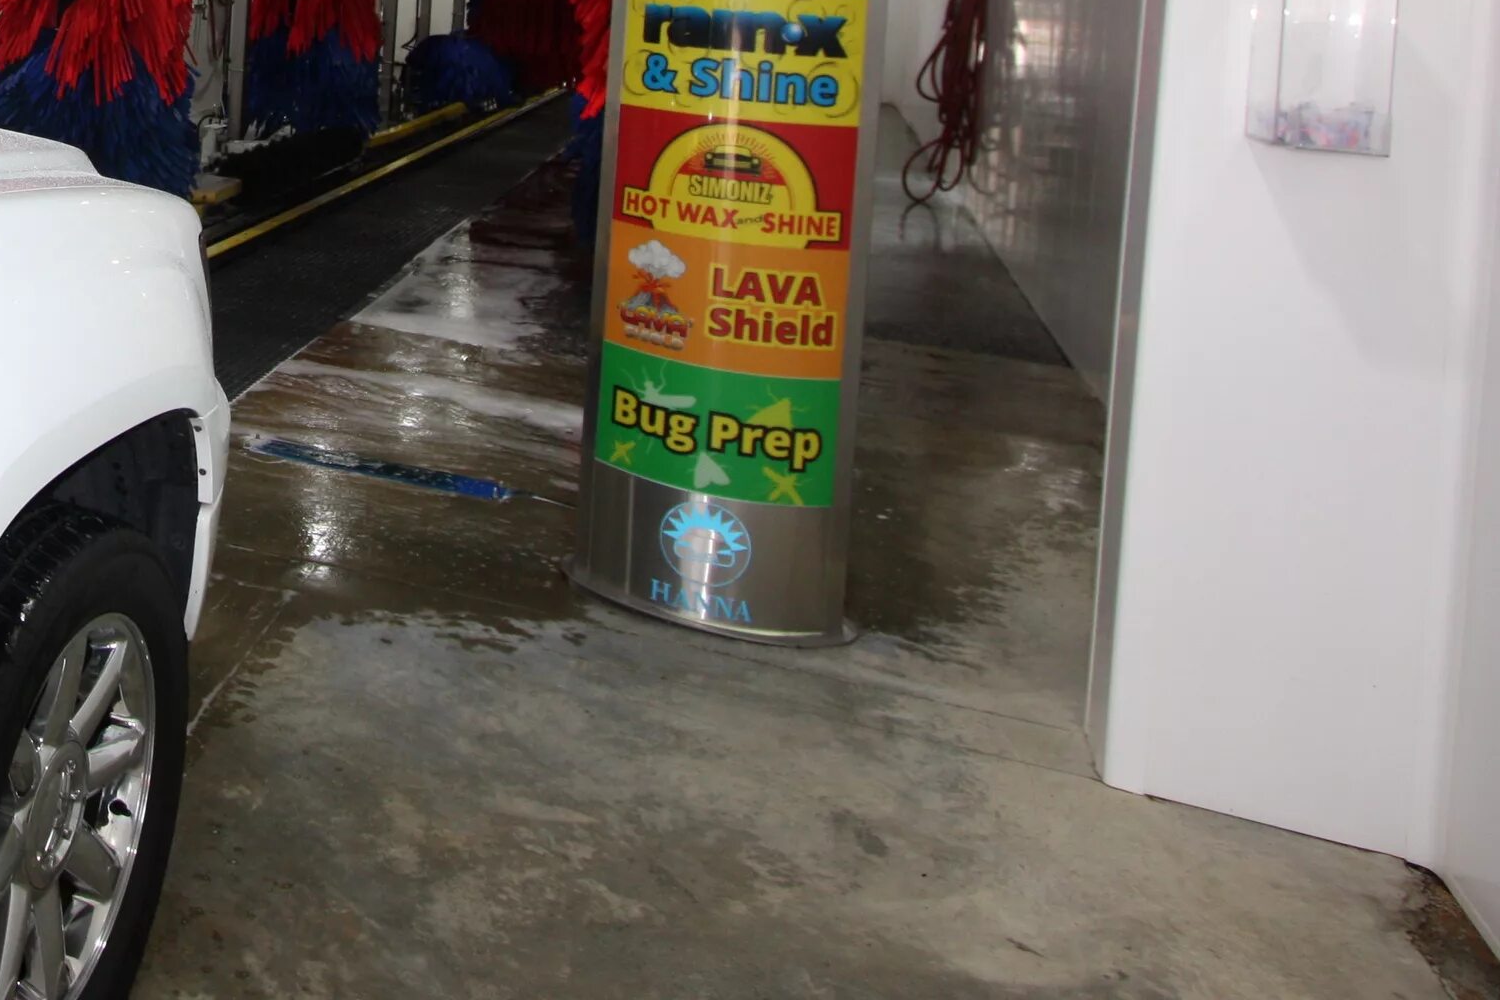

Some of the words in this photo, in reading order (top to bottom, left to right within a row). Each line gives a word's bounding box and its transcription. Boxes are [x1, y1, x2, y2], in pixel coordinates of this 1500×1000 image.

[642, 53, 680, 94] &
[689, 57, 839, 107] Shine
[688, 175, 773, 205] SIMONIZ
[625, 192, 670, 218] HOT
[676, 200, 739, 229] WAX
[760, 212, 839, 238] SHINE
[710, 265, 822, 307] LAVA
[708, 306, 835, 350] Shield
[612, 384, 698, 454] Bug
[709, 410, 823, 472] Prep
[650, 577, 752, 624] HANNA
